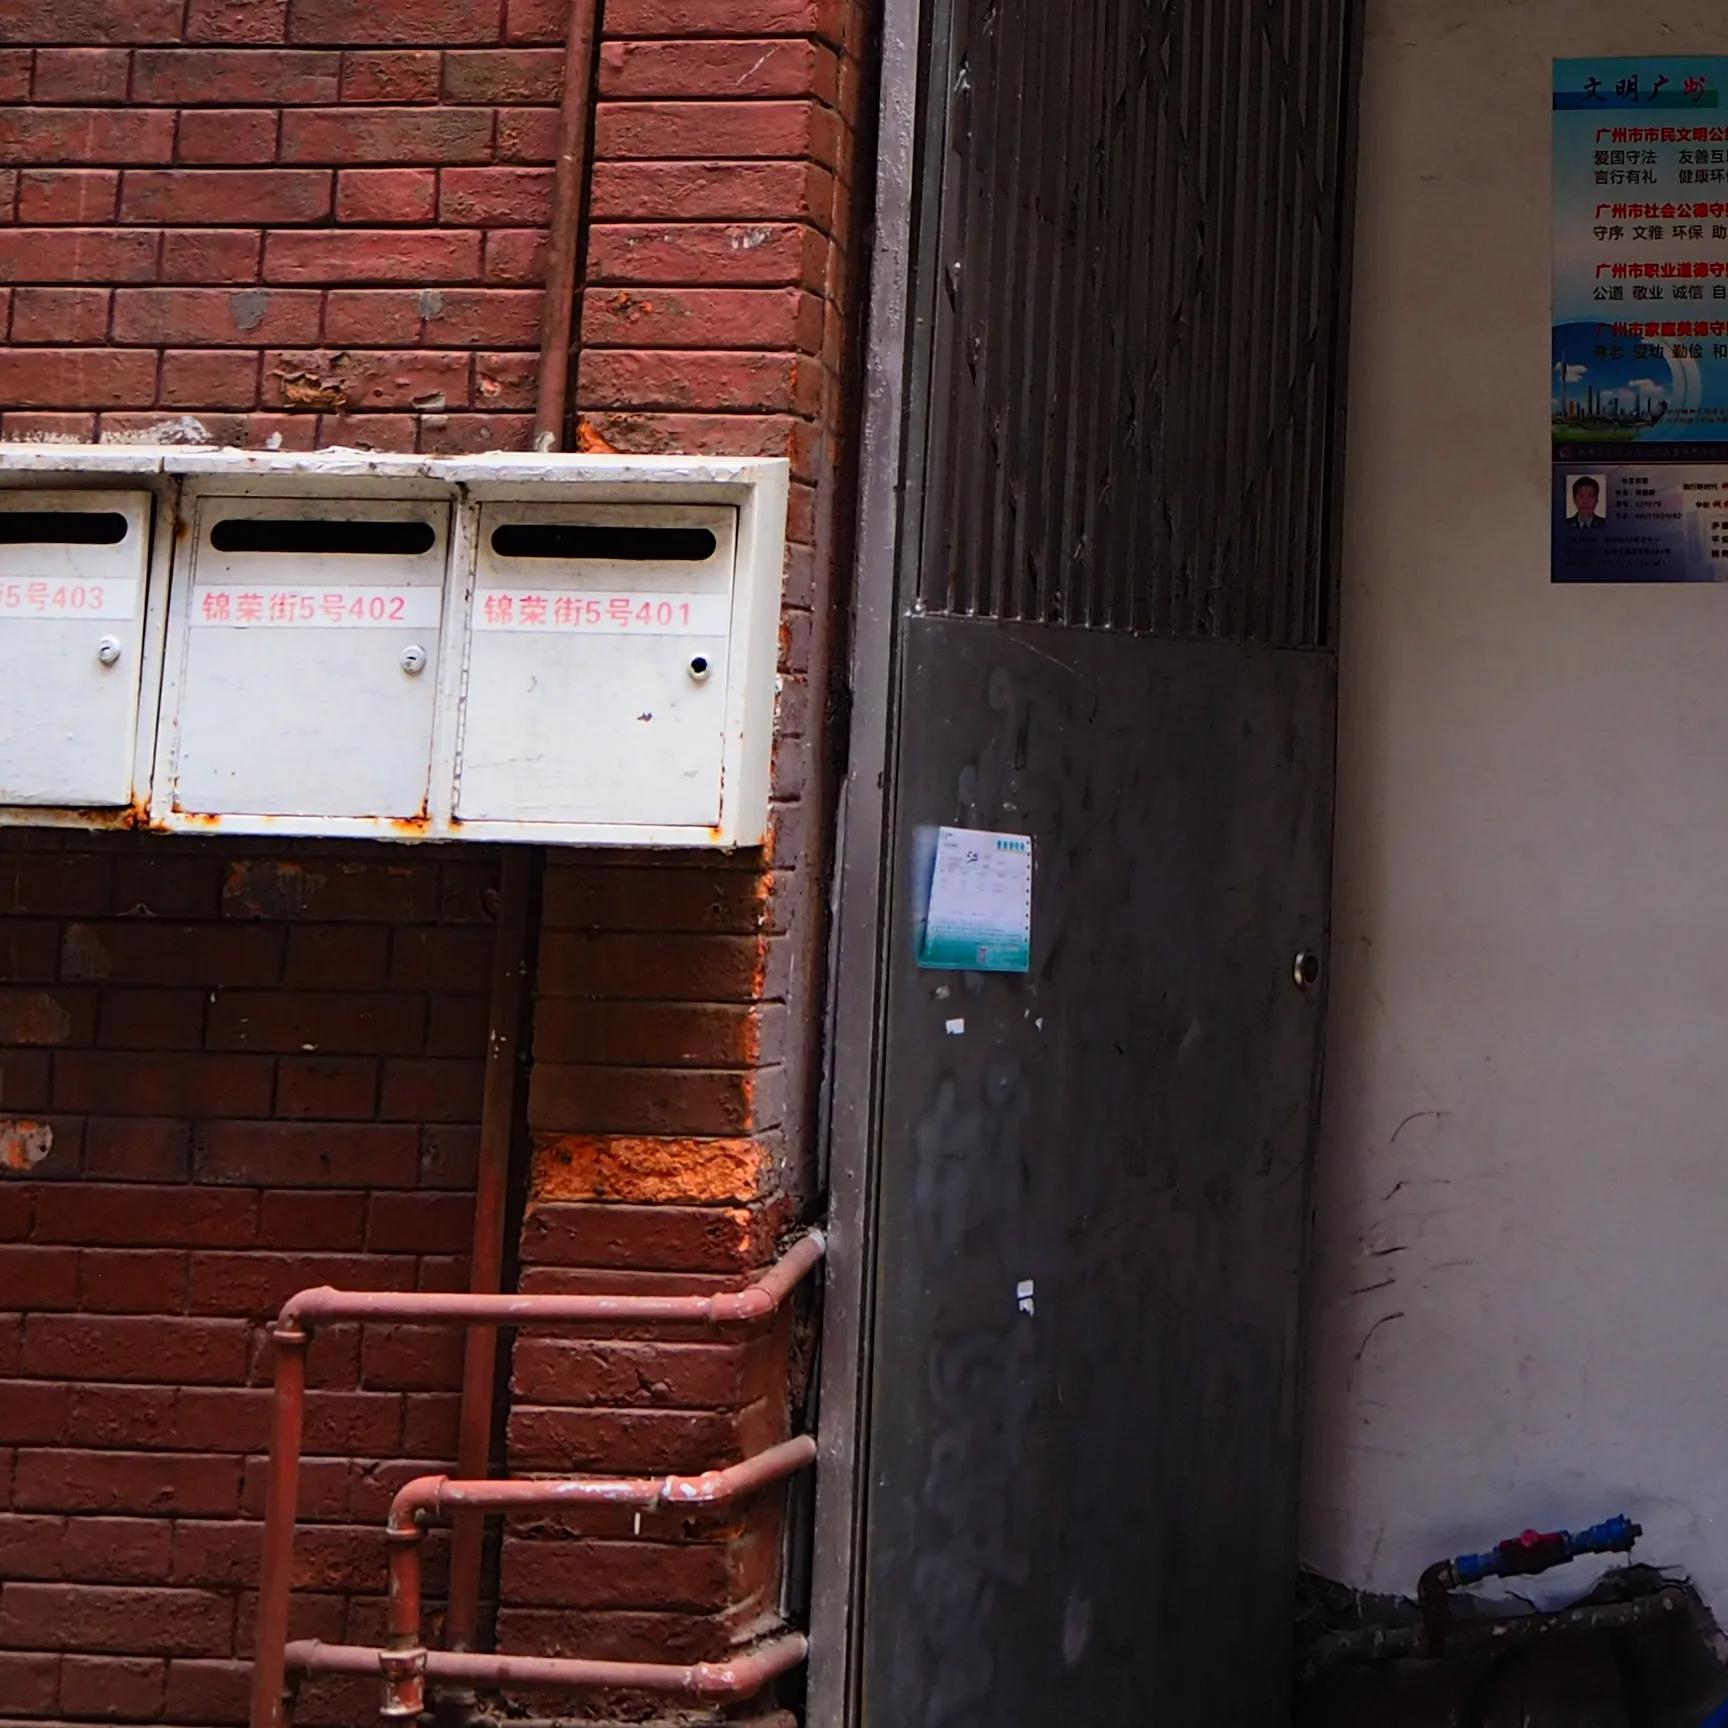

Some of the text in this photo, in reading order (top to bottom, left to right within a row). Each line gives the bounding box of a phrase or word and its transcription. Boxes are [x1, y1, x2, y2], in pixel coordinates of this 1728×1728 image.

[1594, 149, 1657, 165] 爱国守法
[1594, 169, 1657, 184] 言行有礼
[1593, 225, 1624, 240] 守序
[1633, 225, 1664, 240] 文雅
[1672, 225, 1704, 240] 环保
[1593, 285, 1624, 301] 公道
[1633, 285, 1664, 301] 敬业
[1672, 285, 1704, 301] 诚信
[1672, 343, 1704, 359] 勤俭
[203, 592, 406, 621] 锦荣街5号402
[485, 594, 690, 625] 锦荣街5号401
